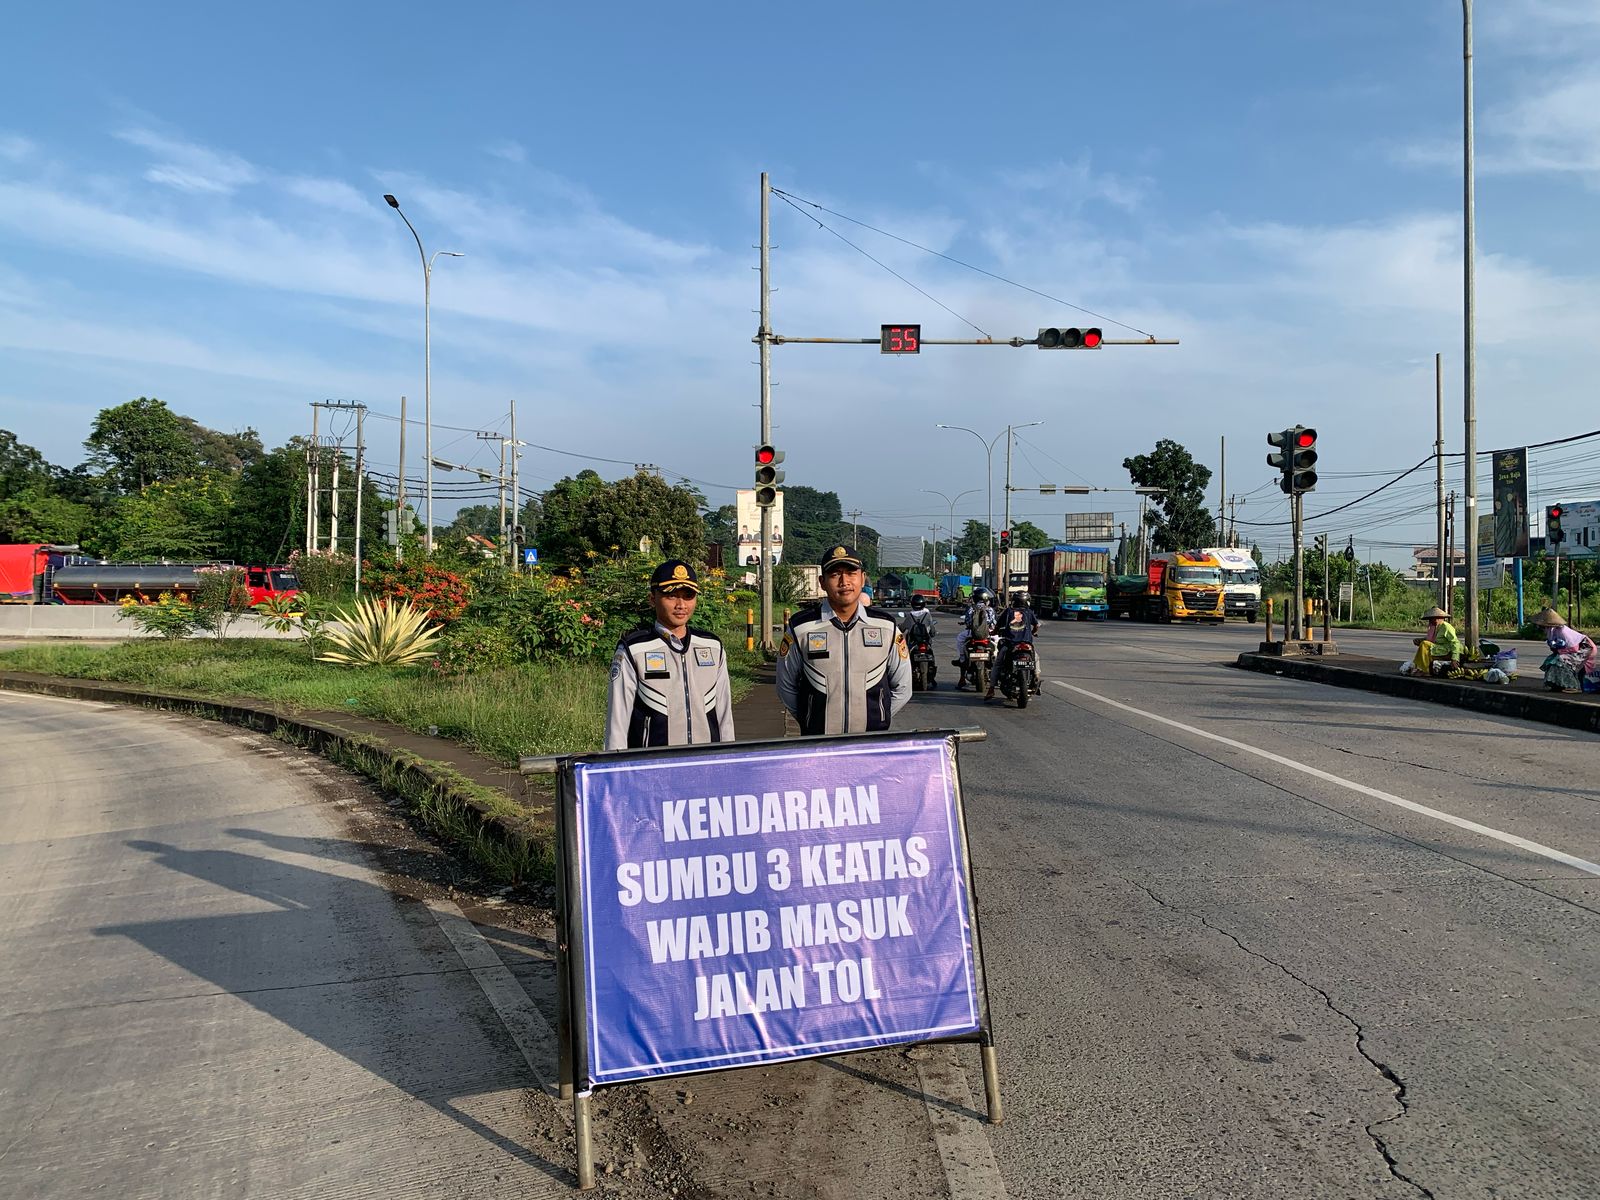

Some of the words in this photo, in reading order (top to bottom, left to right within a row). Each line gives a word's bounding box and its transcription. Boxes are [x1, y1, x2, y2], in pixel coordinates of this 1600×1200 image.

[662, 785, 880, 842] KENDARAAN
[616, 851, 757, 907] SUMBU
[766, 848, 791, 891] 3
[800, 836, 930, 888] KEATAS
[646, 909, 771, 964] WAJIB
[779, 895, 913, 949] MASUK
[694, 964, 806, 1021] JALAN
[812, 957, 881, 1005] TOL
